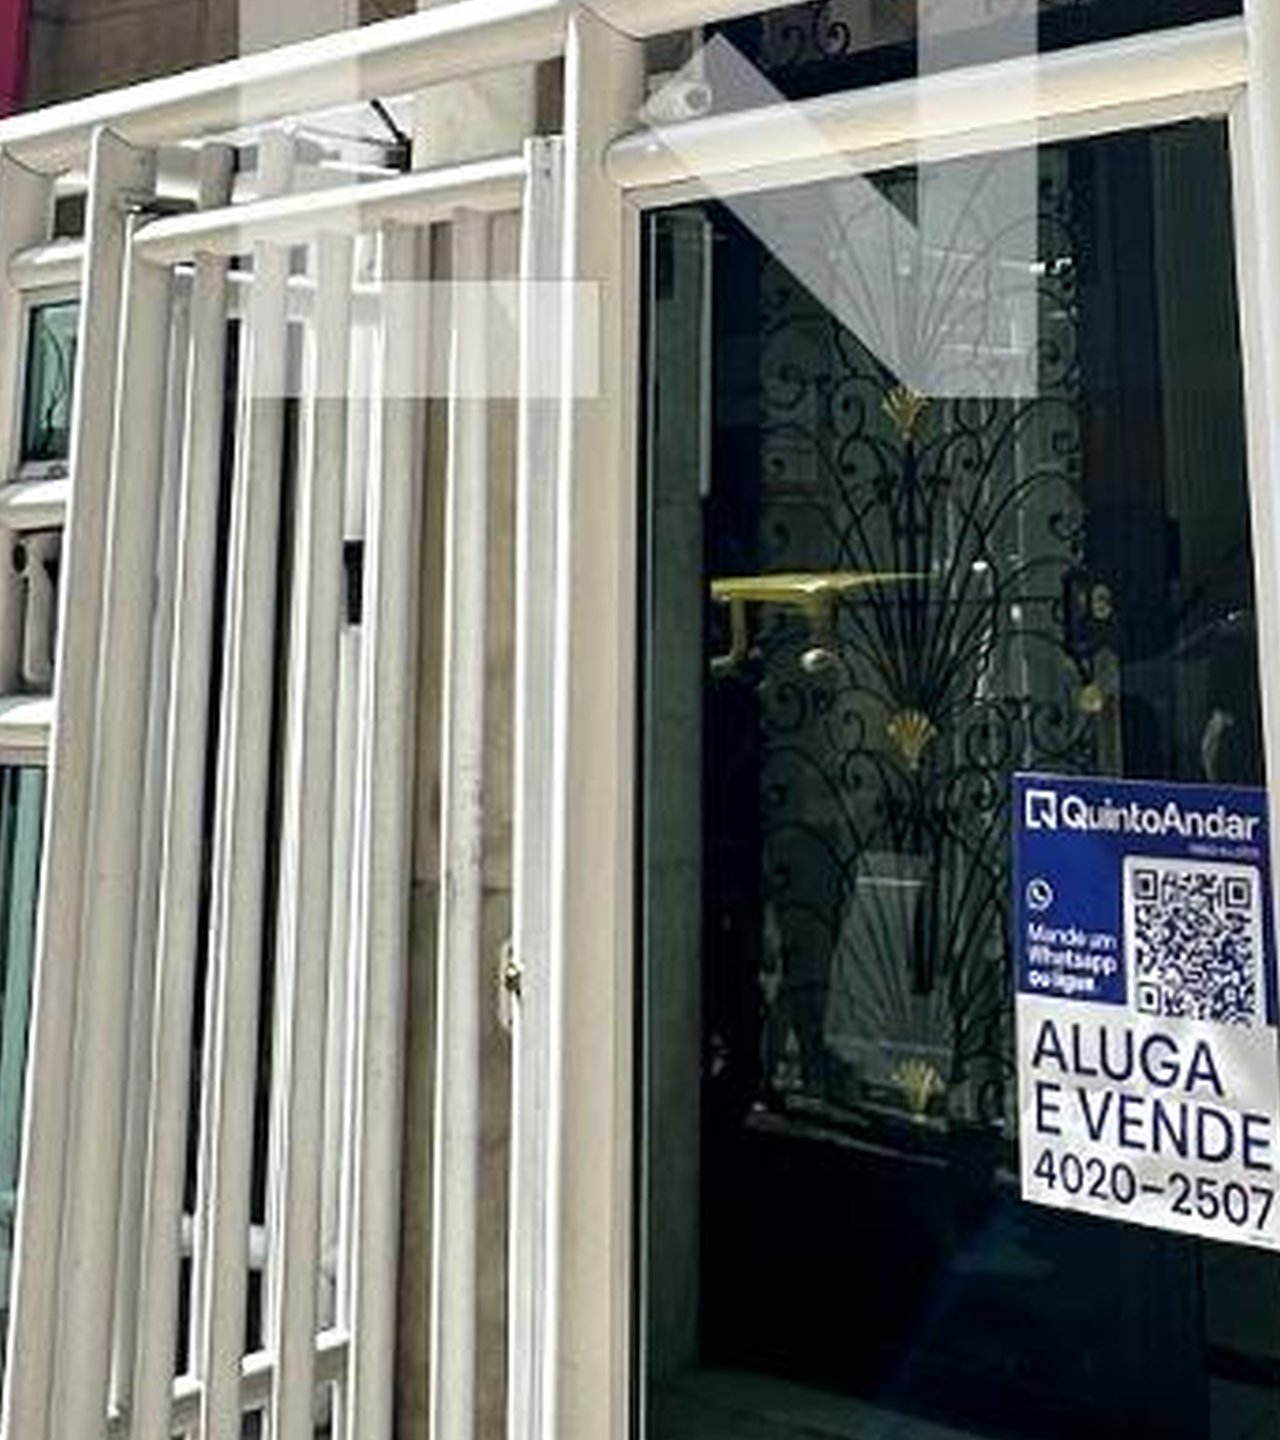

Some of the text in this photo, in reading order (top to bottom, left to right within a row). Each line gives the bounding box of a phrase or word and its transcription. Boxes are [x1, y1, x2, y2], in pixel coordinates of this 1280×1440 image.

[1061, 795, 1260, 841] QuintoAndar
[1032, 1019, 1224, 1098] ALUGA
[1035, 1080, 1272, 1171] E VENDE
[1034, 1149, 1274, 1231] 4020-2507
